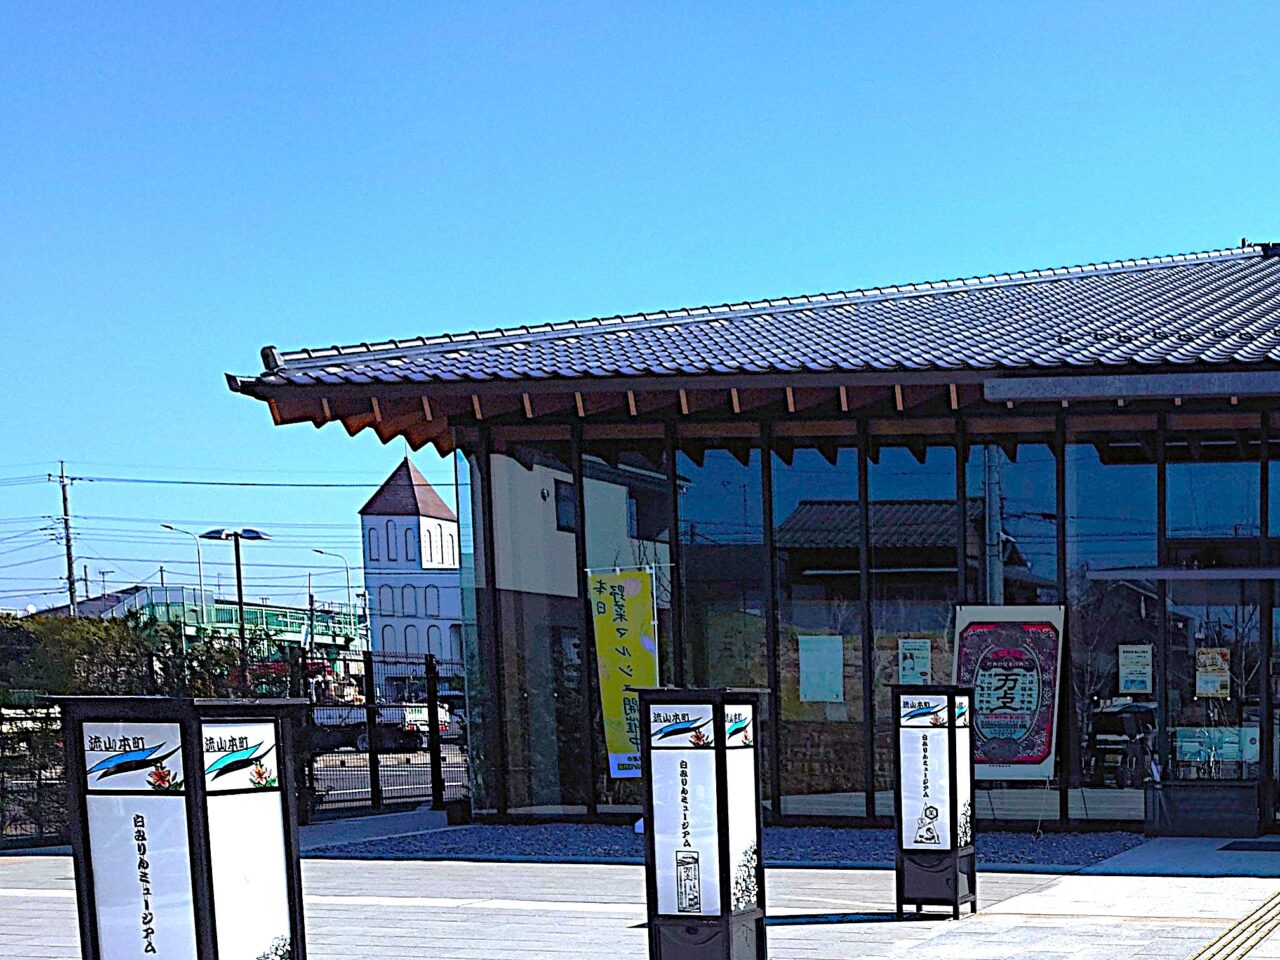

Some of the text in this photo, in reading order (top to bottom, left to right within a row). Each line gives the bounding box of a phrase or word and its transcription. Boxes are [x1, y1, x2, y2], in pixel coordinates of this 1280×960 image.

[652, 711, 690, 723] 流山本町
[88, 735, 145, 751] 流山本町
[204, 736, 249, 752] 流山本町
[679, 759, 691, 848] 白みりんミュージアム
[132, 813, 157, 954] 白みりんミュージアム
